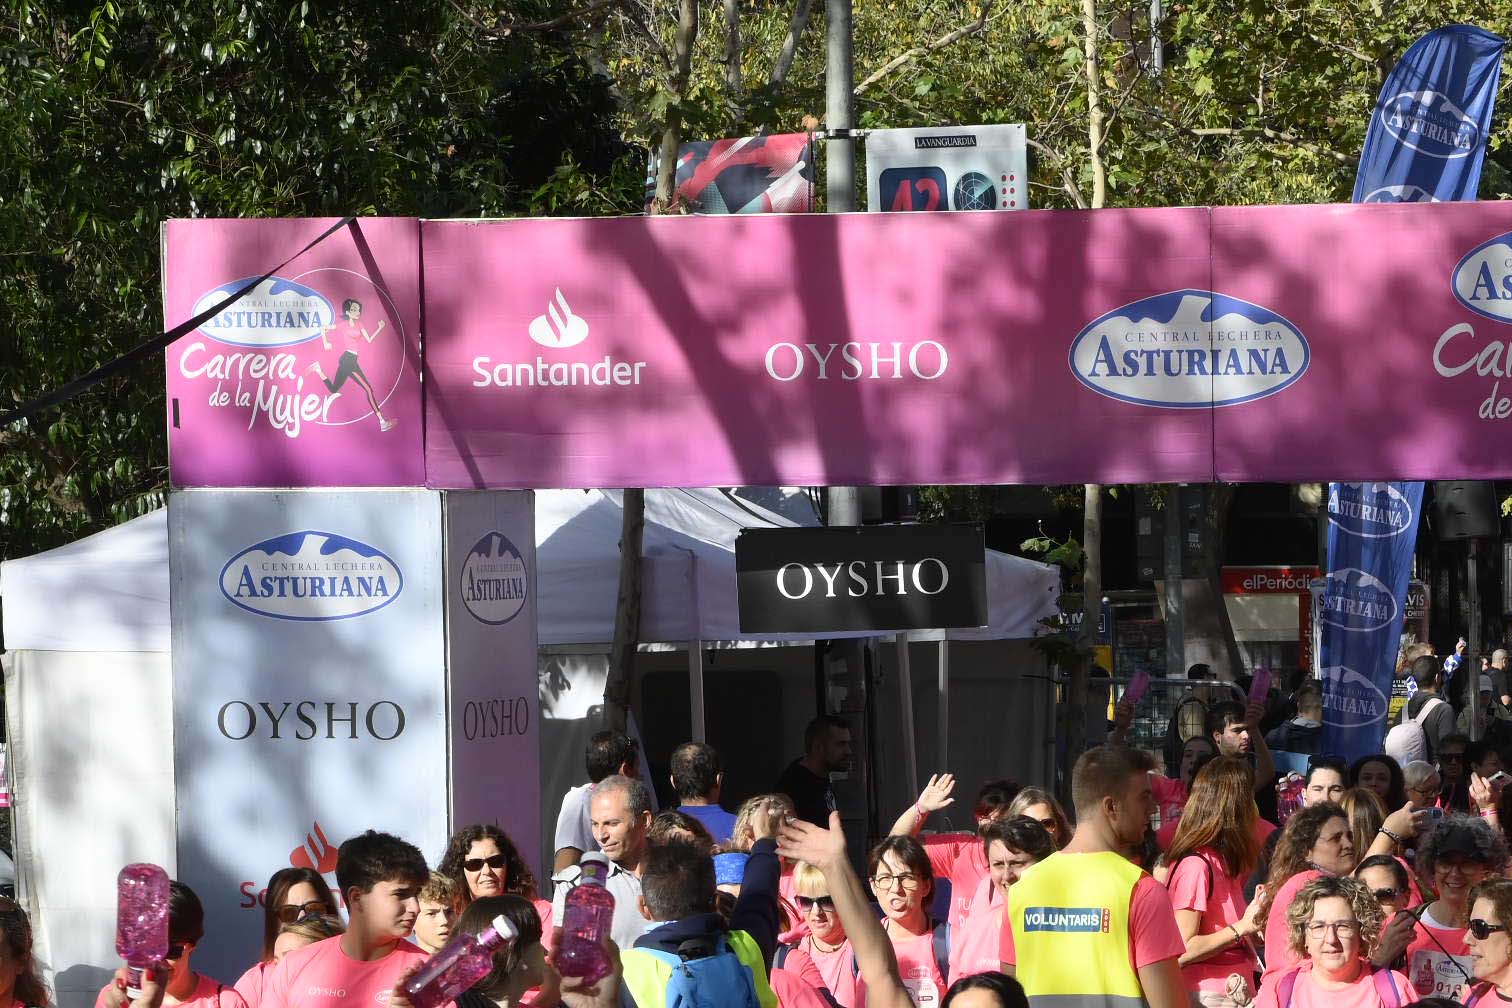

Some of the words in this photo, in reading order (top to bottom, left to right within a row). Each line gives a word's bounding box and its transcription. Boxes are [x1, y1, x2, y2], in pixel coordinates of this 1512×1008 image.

[1388, 104, 1471, 150] ASTURIANA
[1124, 331, 1200, 343] CENTRAL
[1208, 330, 1283, 342] LECHERA
[180, 343, 297, 380] Carrera
[472, 357, 646, 387] Santander
[765, 340, 949, 382] OYSHO
[1088, 341, 1291, 378] ASTURIANA
[209, 381, 230, 407] de
[235, 382, 251, 407] la
[248, 377, 341, 438] Mujer
[1478, 380, 1512, 419] de
[1328, 489, 1403, 527] ASTURIANA
[234, 564, 390, 599] ASTURIANA
[262, 562, 317, 571] CENTRAL
[324, 562, 384, 571] LECHERA
[466, 565, 524, 602] ASTURIANA
[777, 558, 949, 599] OYSHO
[217, 700, 406, 741] OYSHO
[463, 696, 529, 741] OYSHO
[1025, 912, 1100, 927] VOLUNTARIS
